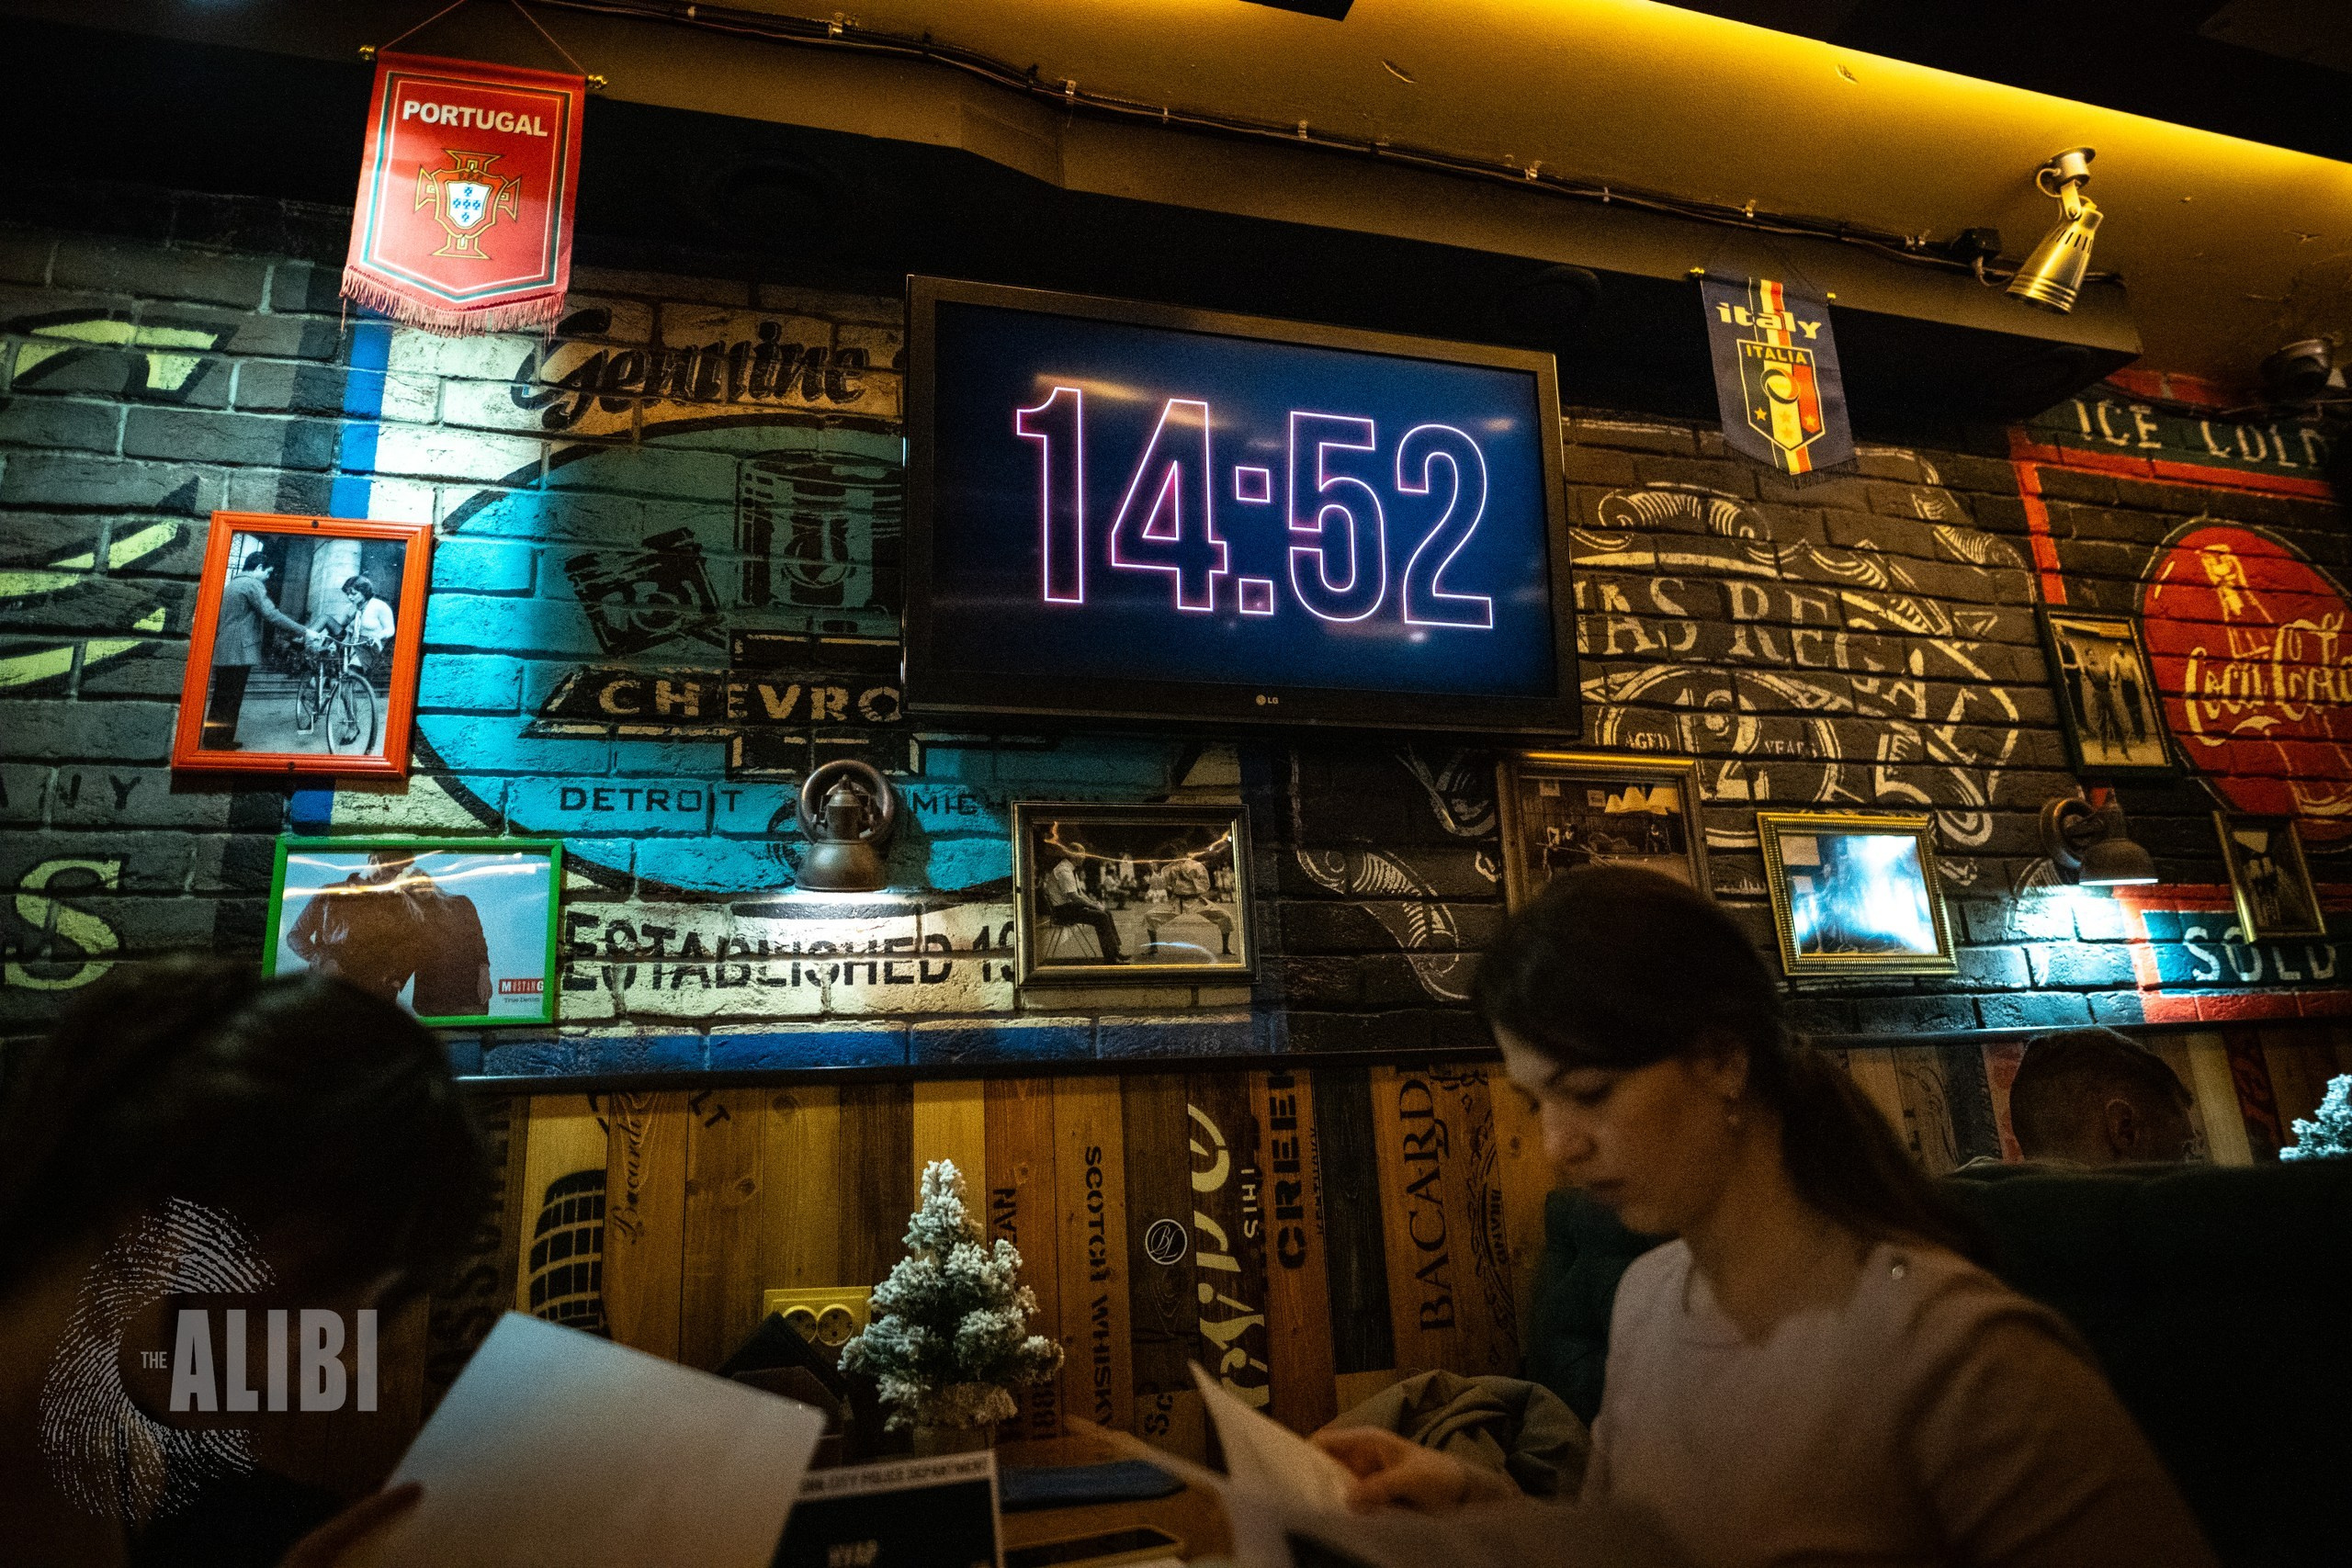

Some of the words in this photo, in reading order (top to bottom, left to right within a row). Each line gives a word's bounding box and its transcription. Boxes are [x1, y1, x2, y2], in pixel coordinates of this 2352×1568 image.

[401, 100, 548, 137] PORTUGAL
[1716, 301, 1822, 340] italy
[511, 307, 870, 429] Genuine
[1747, 344, 1807, 365] ITALIA
[2073, 399, 2163, 450] ICE
[1016, 387, 1493, 629] 14:52
[1268, 696, 1279, 705] LG
[560, 785, 742, 813] DETROIT
[2183, 925, 2337, 983] SOLD
[502, 980, 544, 992] MUSTANG
[1081, 1145, 1109, 1282] SCOTCH
